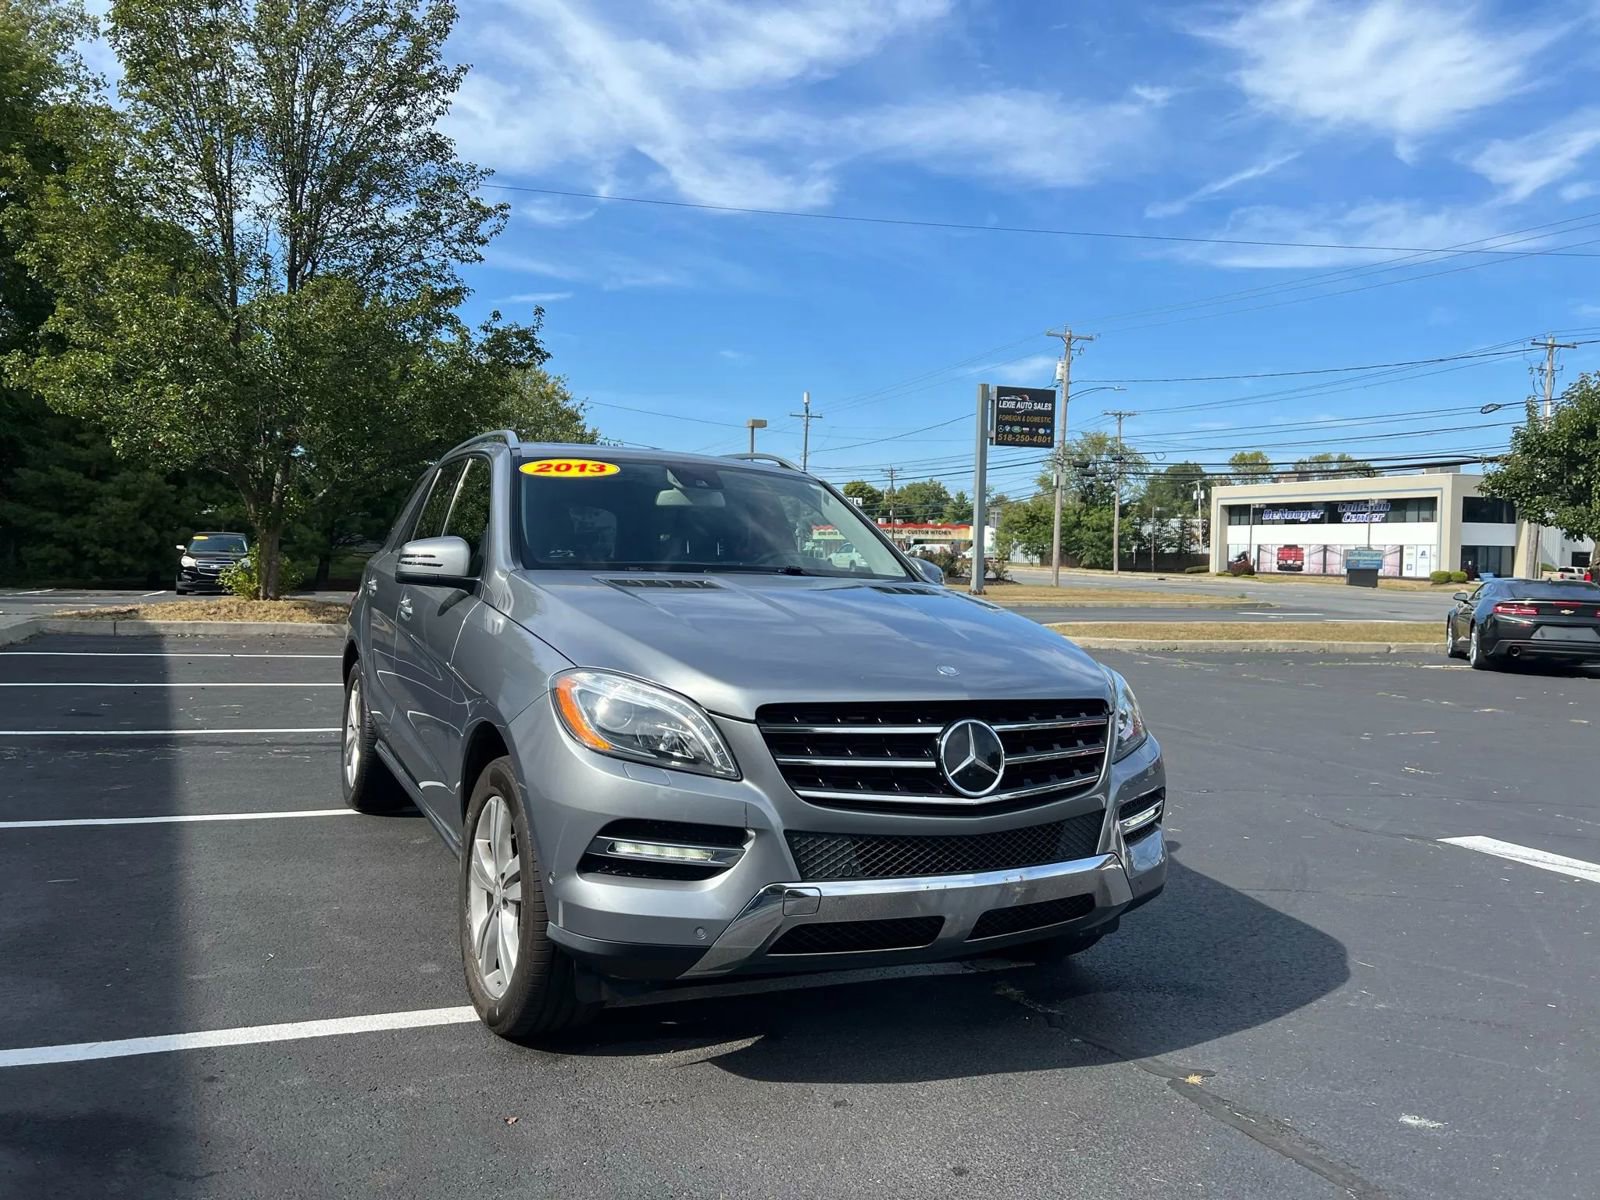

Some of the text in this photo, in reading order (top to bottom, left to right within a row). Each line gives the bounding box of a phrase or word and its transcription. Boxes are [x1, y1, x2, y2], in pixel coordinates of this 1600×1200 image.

[1016, 401, 1032, 409] AUTO
[1033, 402, 1052, 410] SALES
[998, 434, 1052, 443] 518-250-4801
[534, 463, 606, 472] 2013
[1342, 512, 1385, 522] Center
